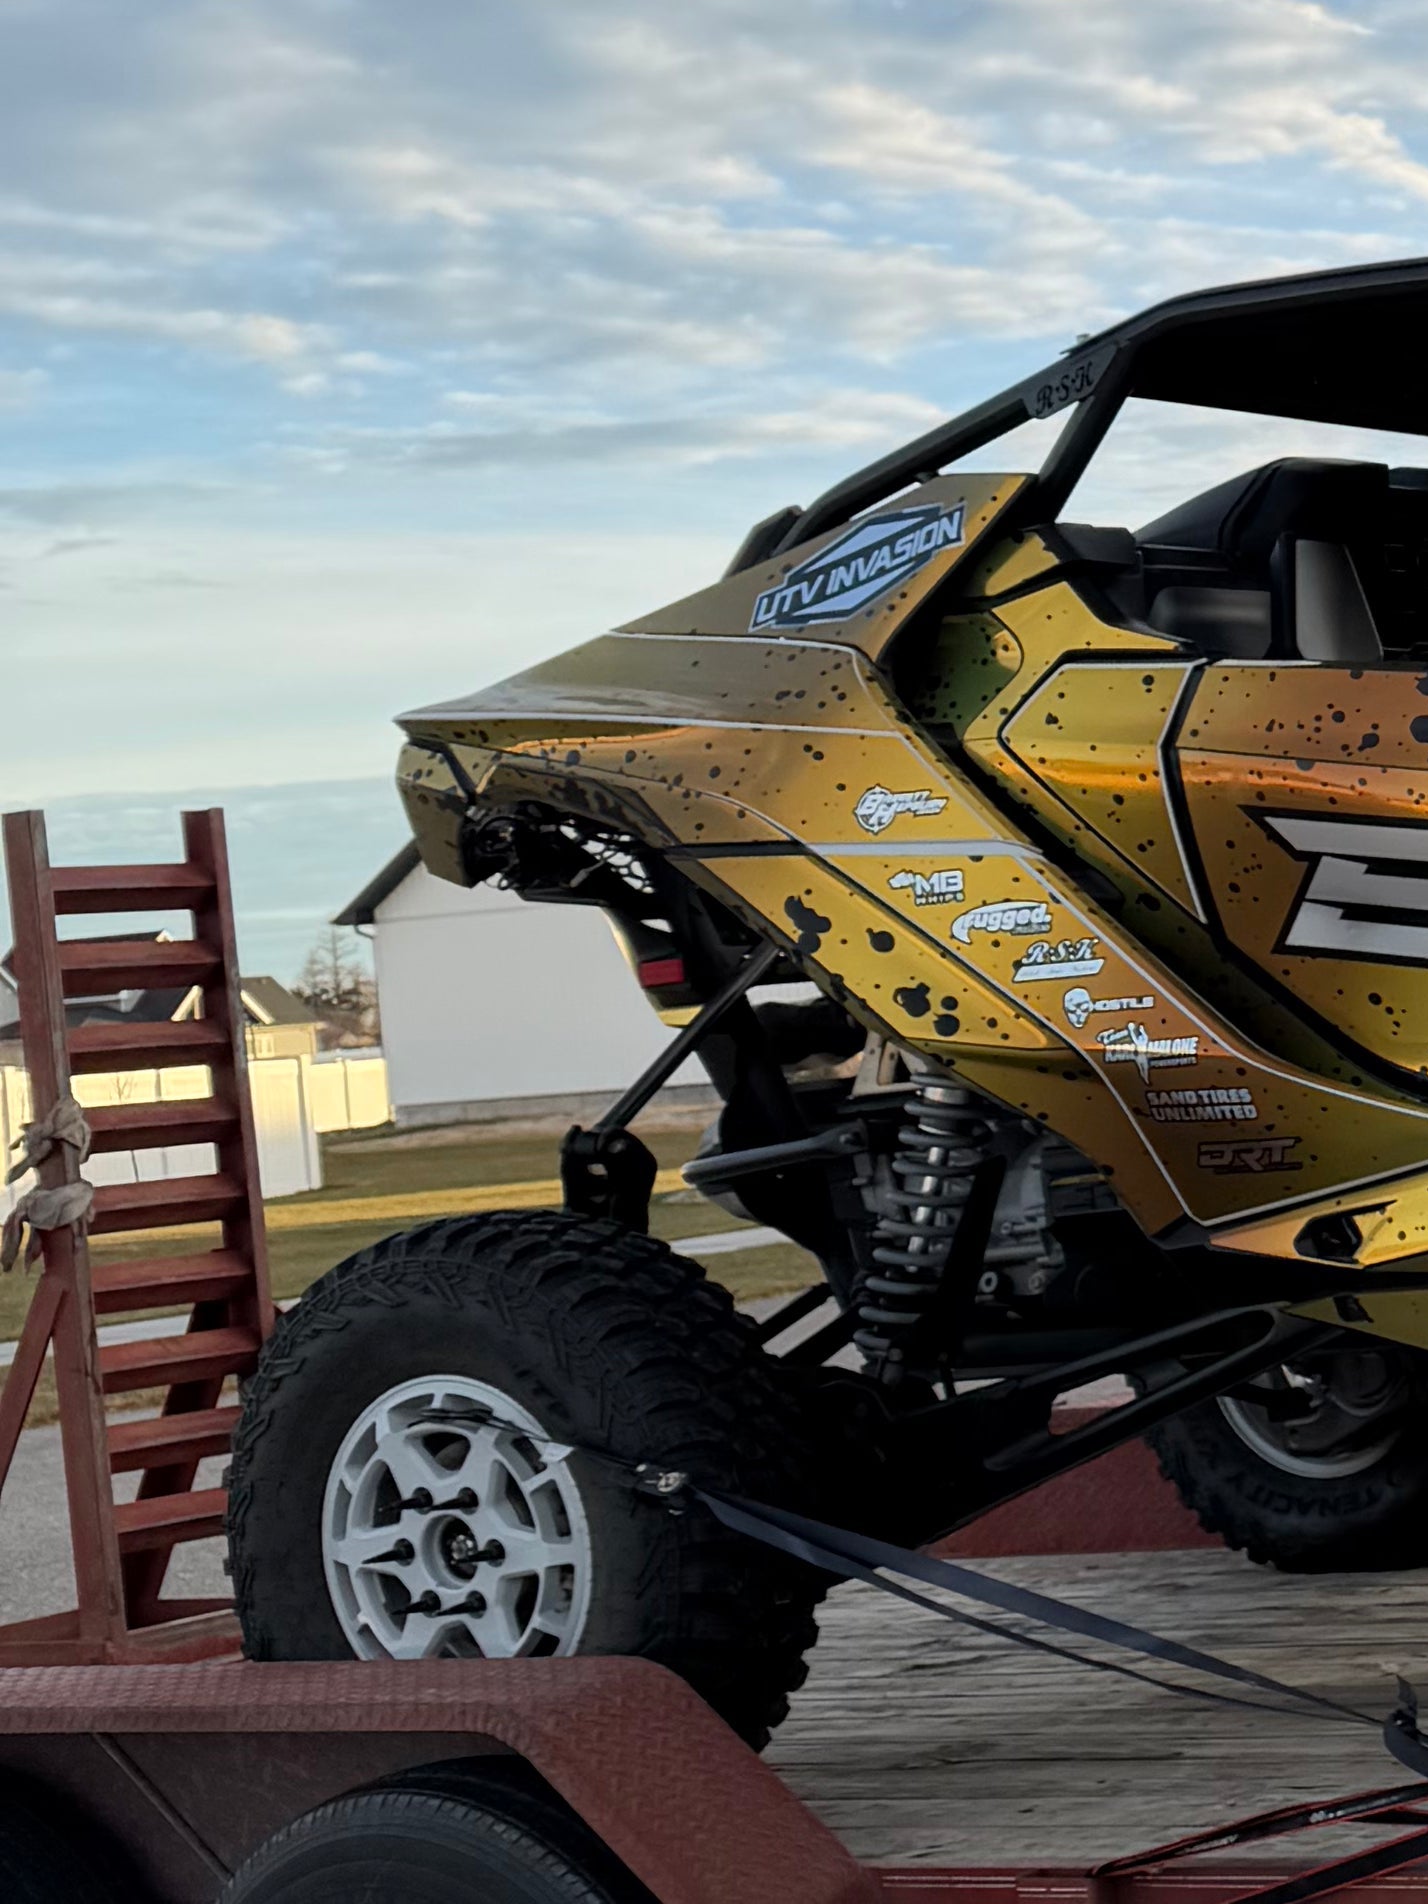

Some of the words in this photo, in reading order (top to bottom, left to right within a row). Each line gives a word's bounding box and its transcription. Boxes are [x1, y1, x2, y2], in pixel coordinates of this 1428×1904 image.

[755, 573, 826, 624] UTV
[825, 510, 961, 596] INVASION
[913, 869, 964, 896] MB
[1147, 1090, 1198, 1106] SAND
[1198, 1088, 1252, 1104] TIRES
[1151, 1104, 1258, 1121] UNLIMITED
